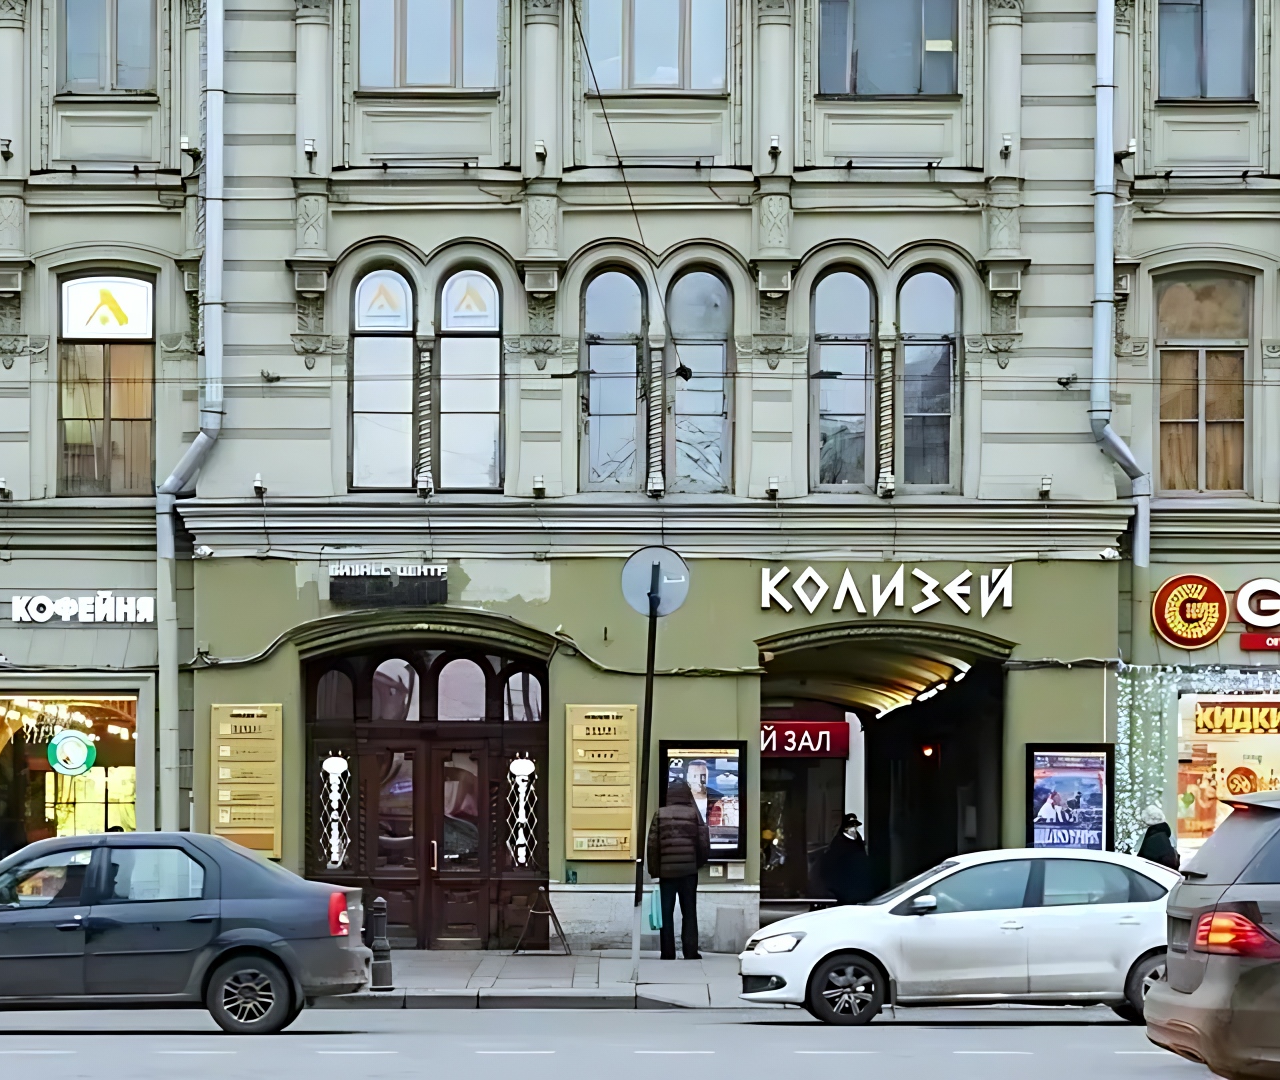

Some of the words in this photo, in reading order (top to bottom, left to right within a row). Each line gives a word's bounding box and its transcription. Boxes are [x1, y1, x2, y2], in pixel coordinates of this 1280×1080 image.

[12, 590, 155, 623] КОФЕЙНЯ
[761, 563, 1013, 618] КОЛИЗЕЙ
[784, 730, 830, 752] ЗАЛ
